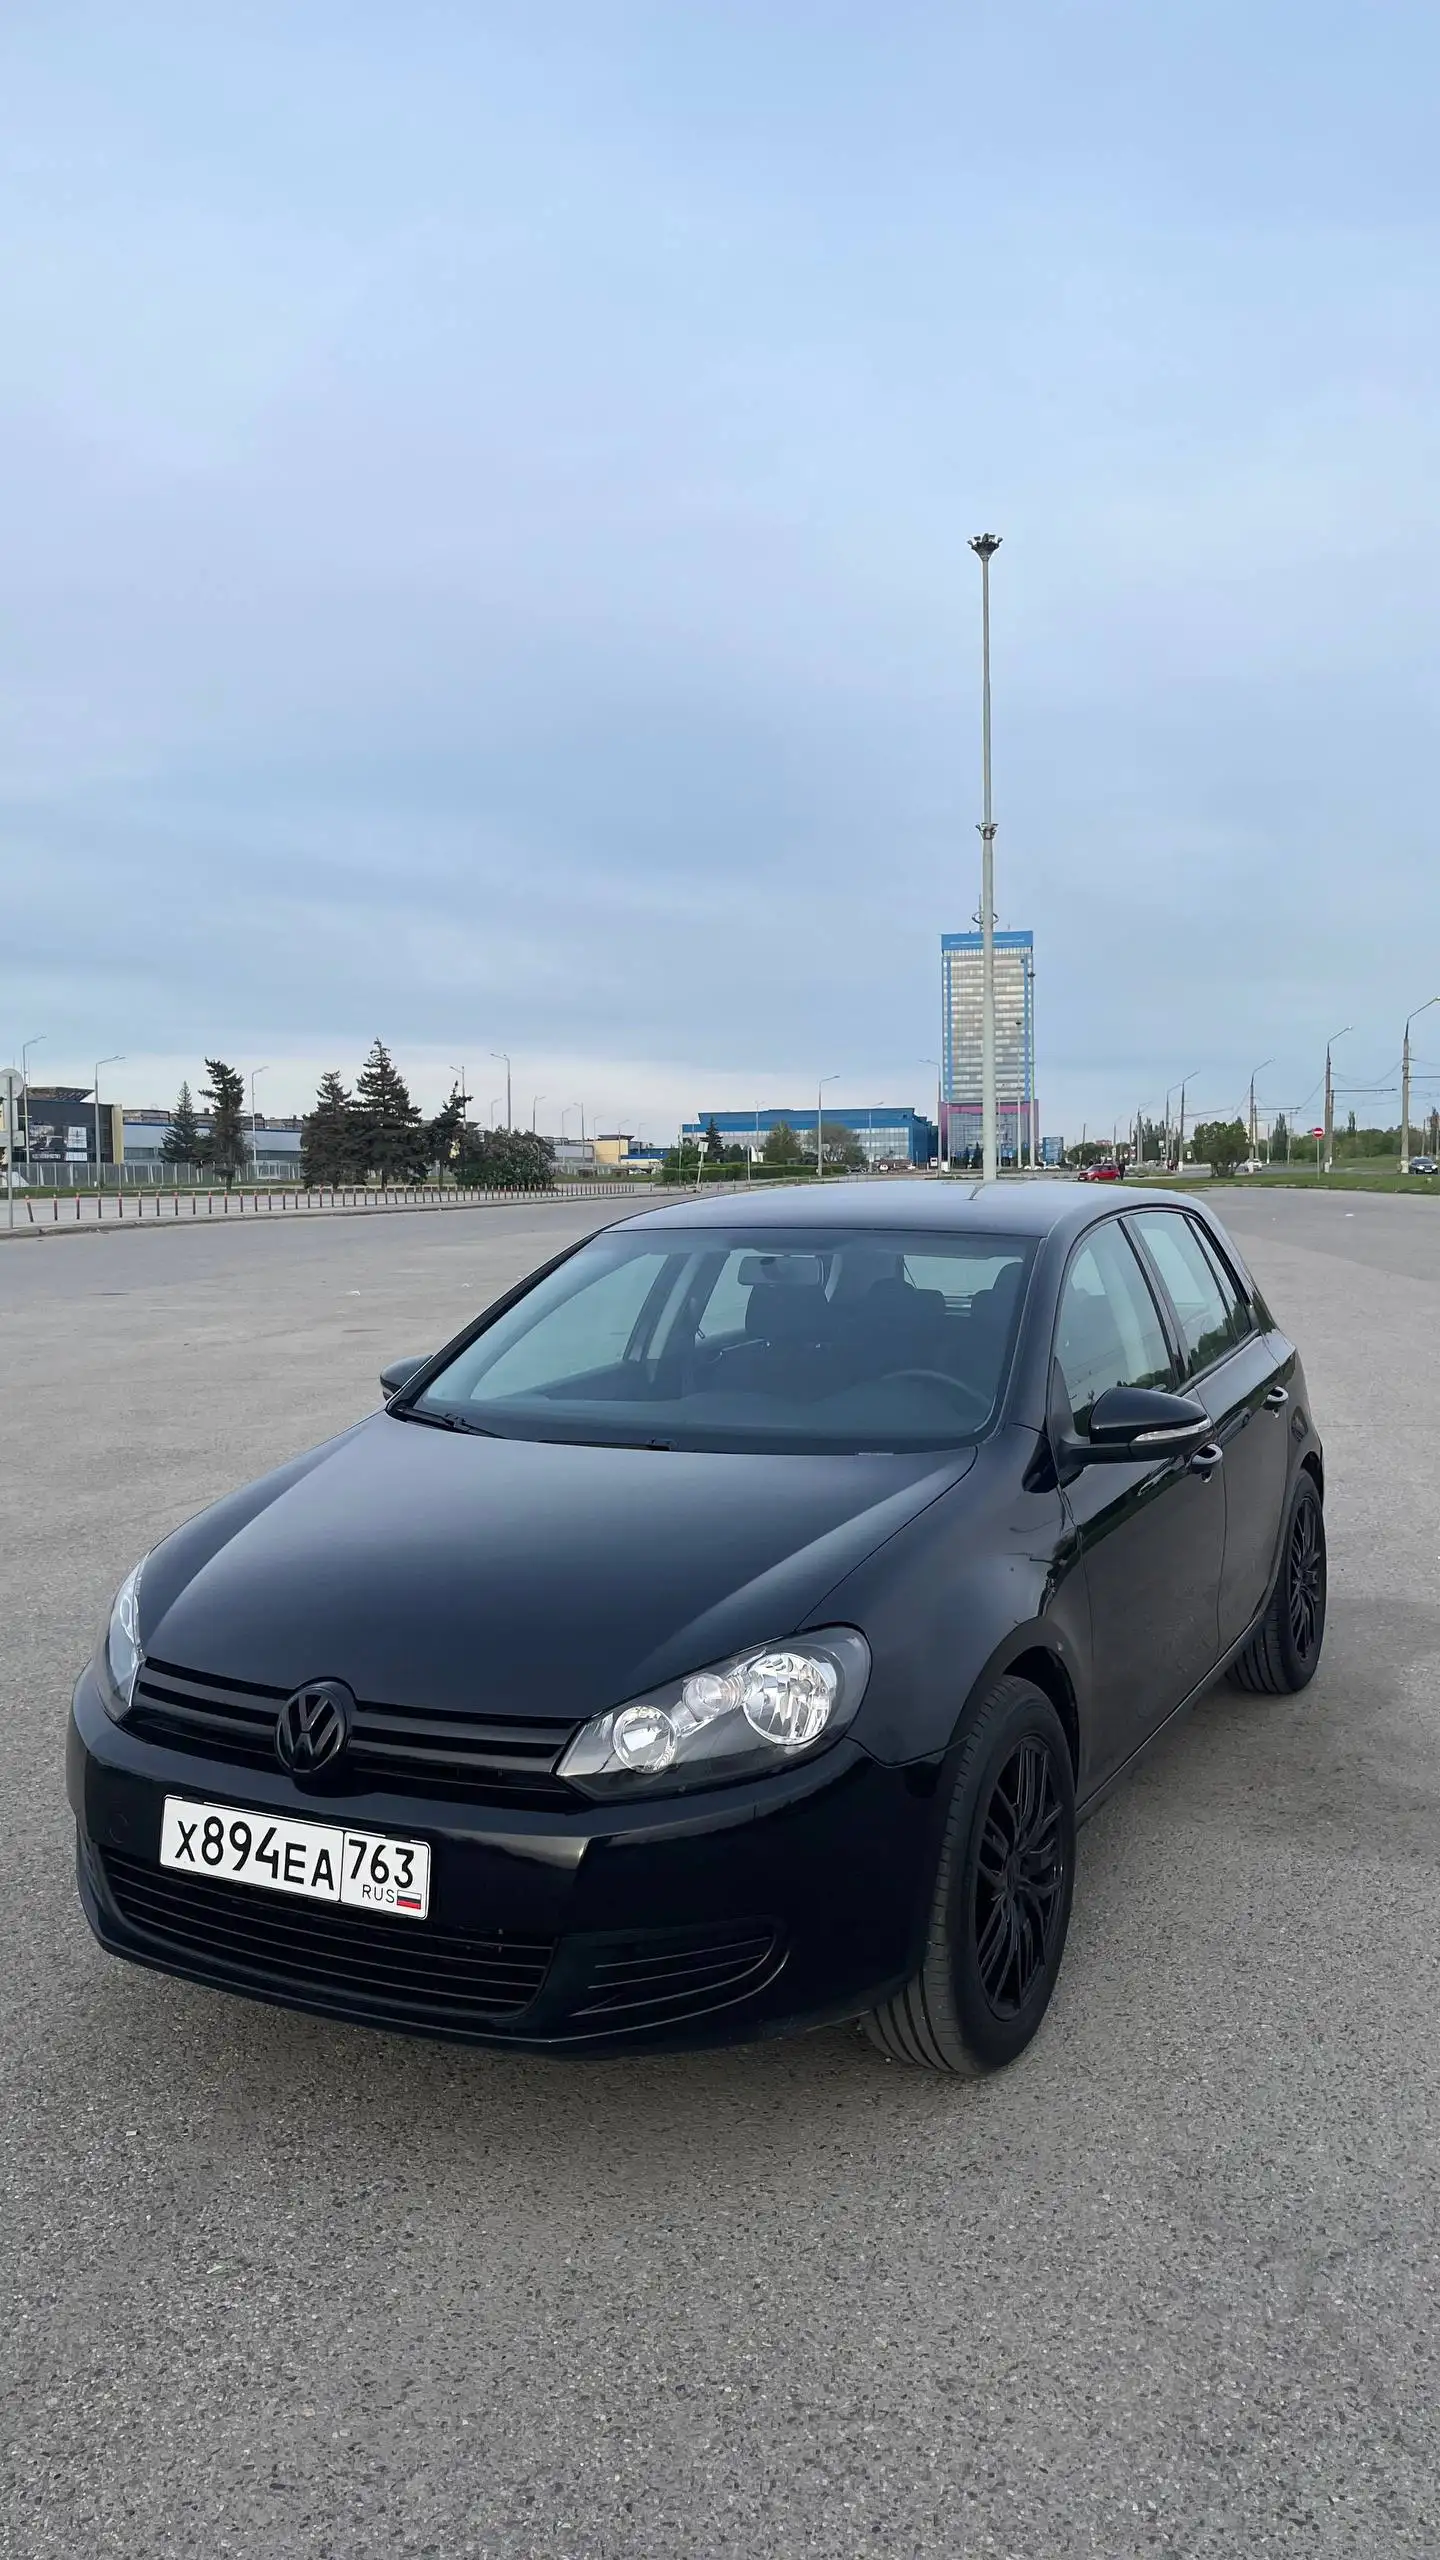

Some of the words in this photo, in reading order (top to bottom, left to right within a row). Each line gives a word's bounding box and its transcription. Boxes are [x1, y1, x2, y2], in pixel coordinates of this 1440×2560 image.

[276, 1685, 346, 1773] VW
[174, 1815, 335, 1891] X894EA
[348, 1838, 415, 1889] 763
[361, 1883, 395, 1904] RUS
